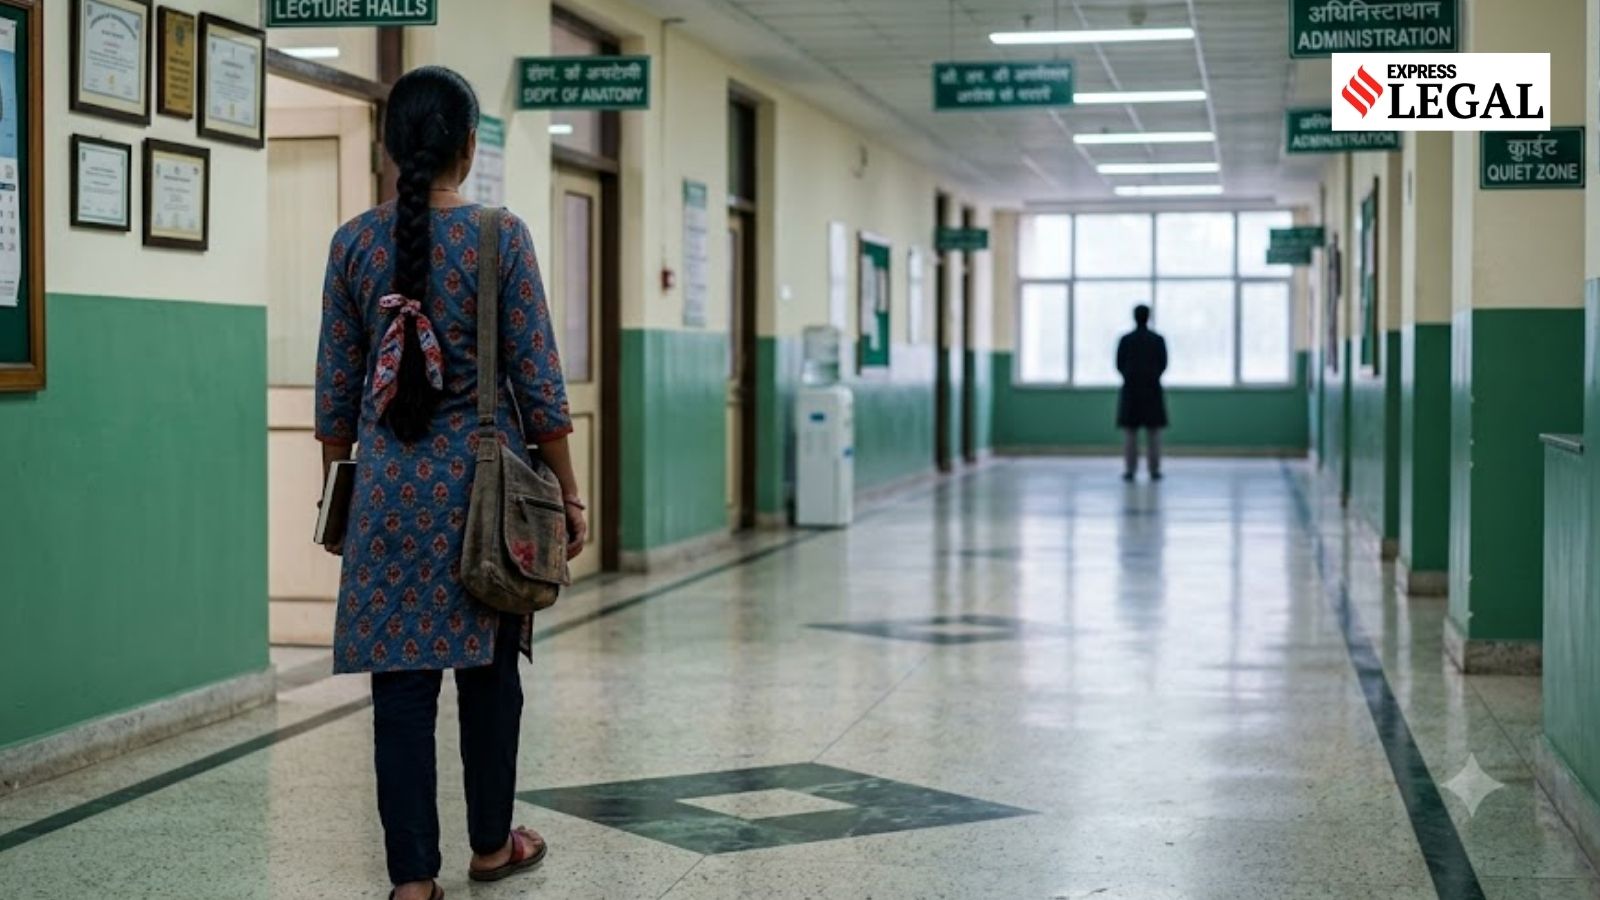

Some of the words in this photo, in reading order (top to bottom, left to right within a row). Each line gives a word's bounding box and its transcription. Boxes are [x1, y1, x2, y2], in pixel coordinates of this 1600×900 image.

[276, 0, 360, 18] LECTURE
[366, 0, 428, 16] HALLS
[1298, 26, 1451, 50] ADMINISTRATION
[1487, 163, 1534, 181] QUIET
[1536, 163, 1578, 180] ZONE
